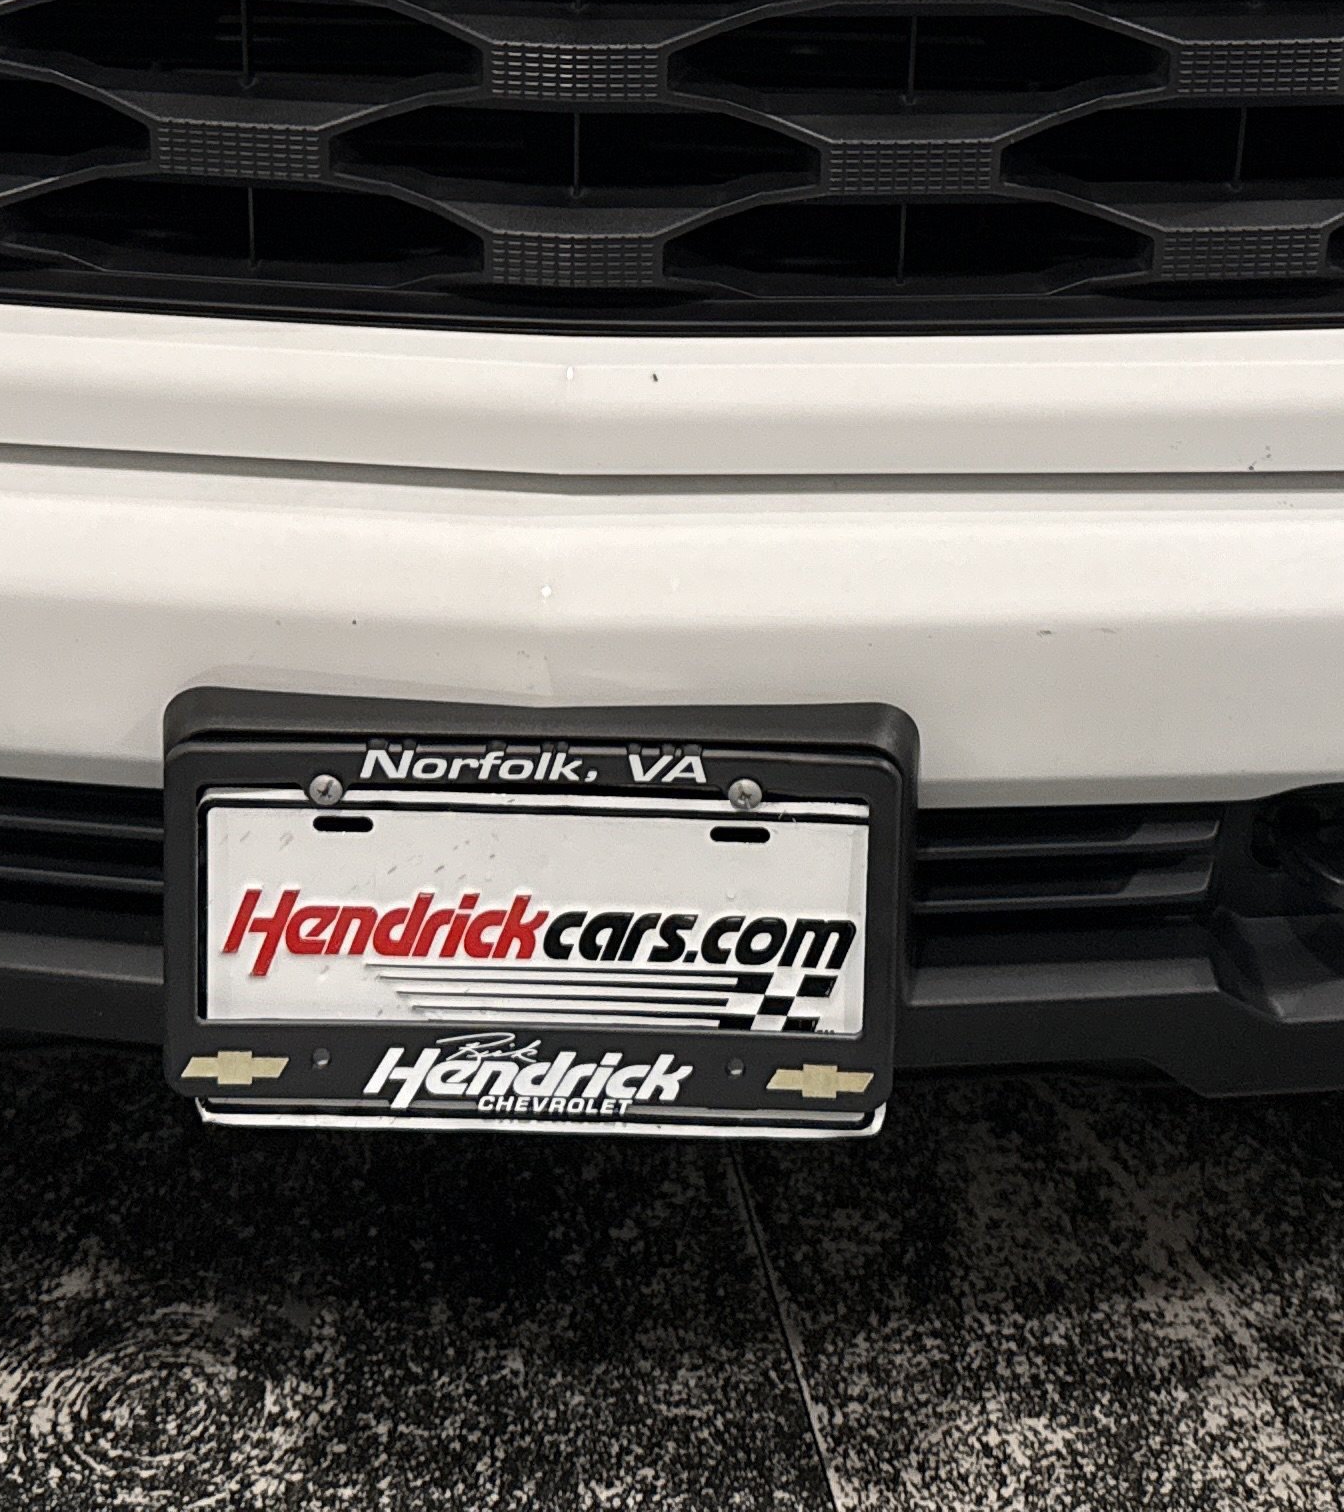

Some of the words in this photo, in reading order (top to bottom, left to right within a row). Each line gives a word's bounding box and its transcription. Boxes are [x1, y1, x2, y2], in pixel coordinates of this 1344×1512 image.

[359, 748, 599, 784] Norfolk,
[627, 752, 708, 785] VA
[220, 888, 857, 978] Hendrickcars.com
[362, 1046, 694, 1109] Hendrick
[476, 1094, 634, 1116] CHEVROLET
